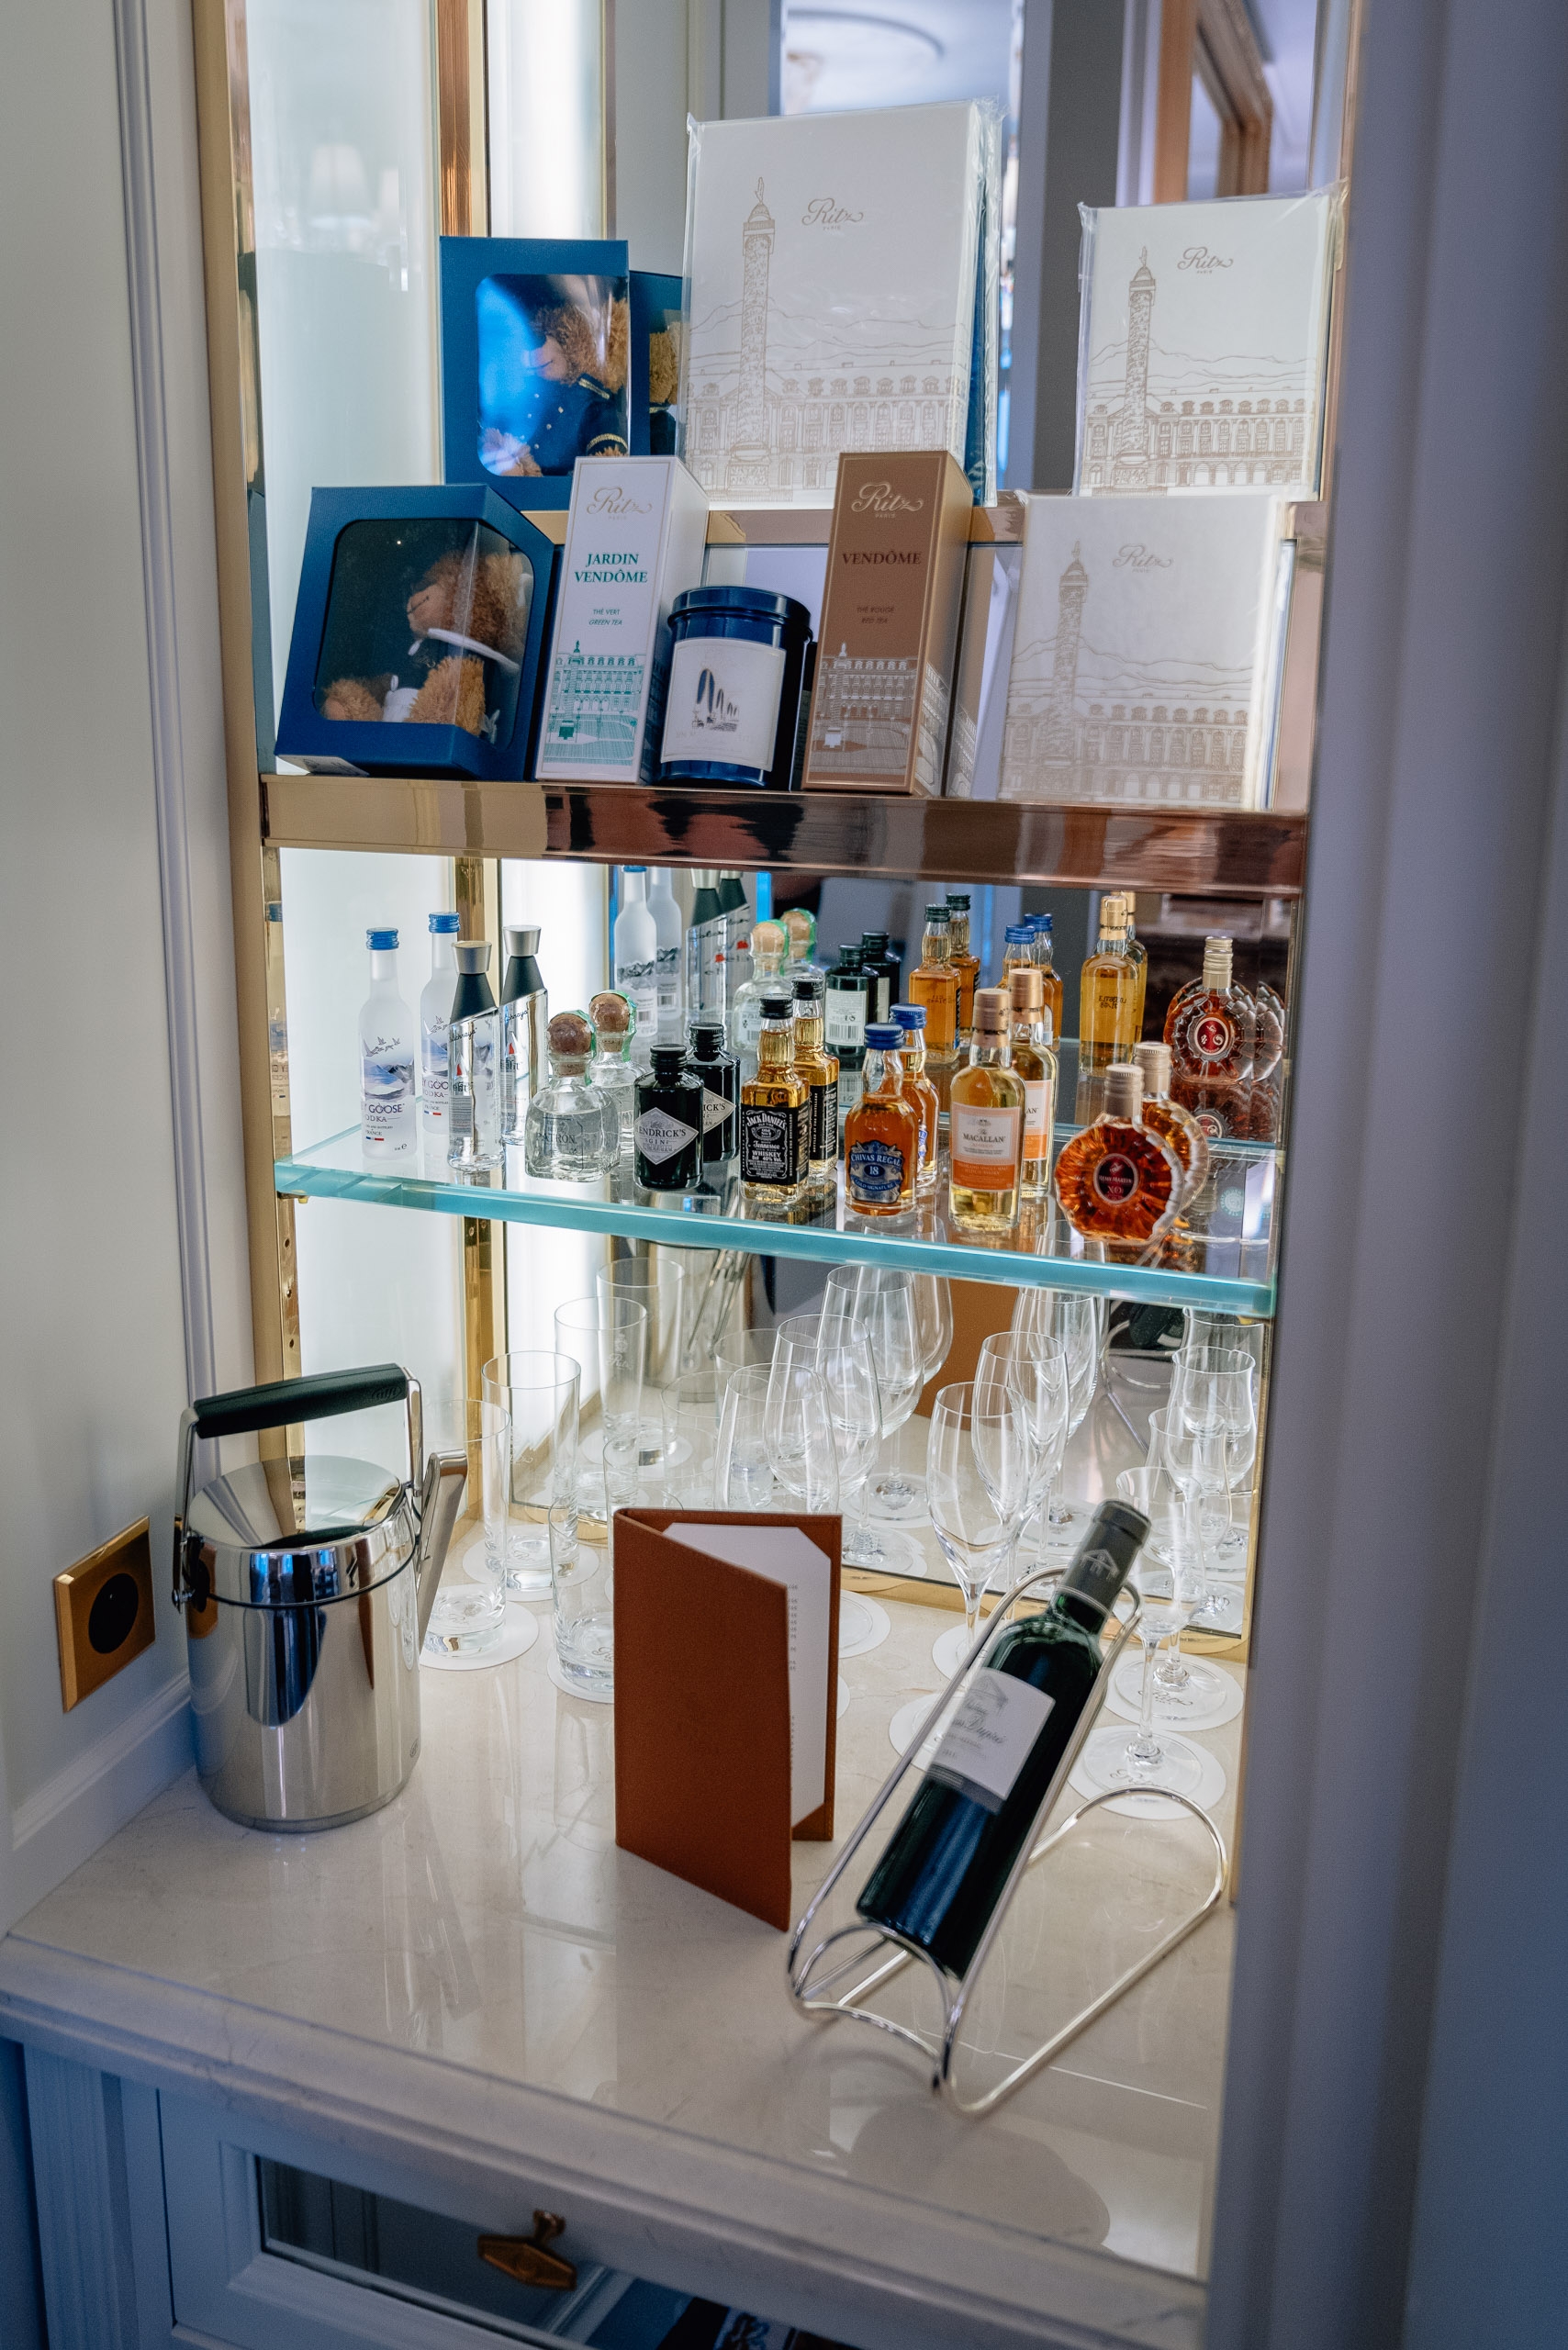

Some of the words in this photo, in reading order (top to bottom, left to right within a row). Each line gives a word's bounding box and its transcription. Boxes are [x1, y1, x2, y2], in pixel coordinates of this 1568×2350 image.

[801, 197, 864, 226] Ritz
[1177, 246, 1233, 270] Ritz
[586, 487, 653, 514] Ritz
[851, 481, 924, 512] Ritz
[586, 552, 640, 567] JARDIN
[842, 551, 922, 565] VENDÔME
[1112, 543, 1172, 568] Ritz
[575, 569, 648, 583] VENDÔME
[593, 607, 604, 615] THÉ
[368, 1103, 403, 1113] GOOSE
[746, 1114, 762, 1127] JACK
[761, 1113, 787, 1131] DANIEL'S
[637, 1126, 687, 1138] ENDRICK'S
[962, 1133, 1004, 1143] MACALLAN
[851, 1153, 875, 1162] CHIVAS
[876, 1155, 901, 1166] REGAL
[869, 1166, 879, 1175] 18
